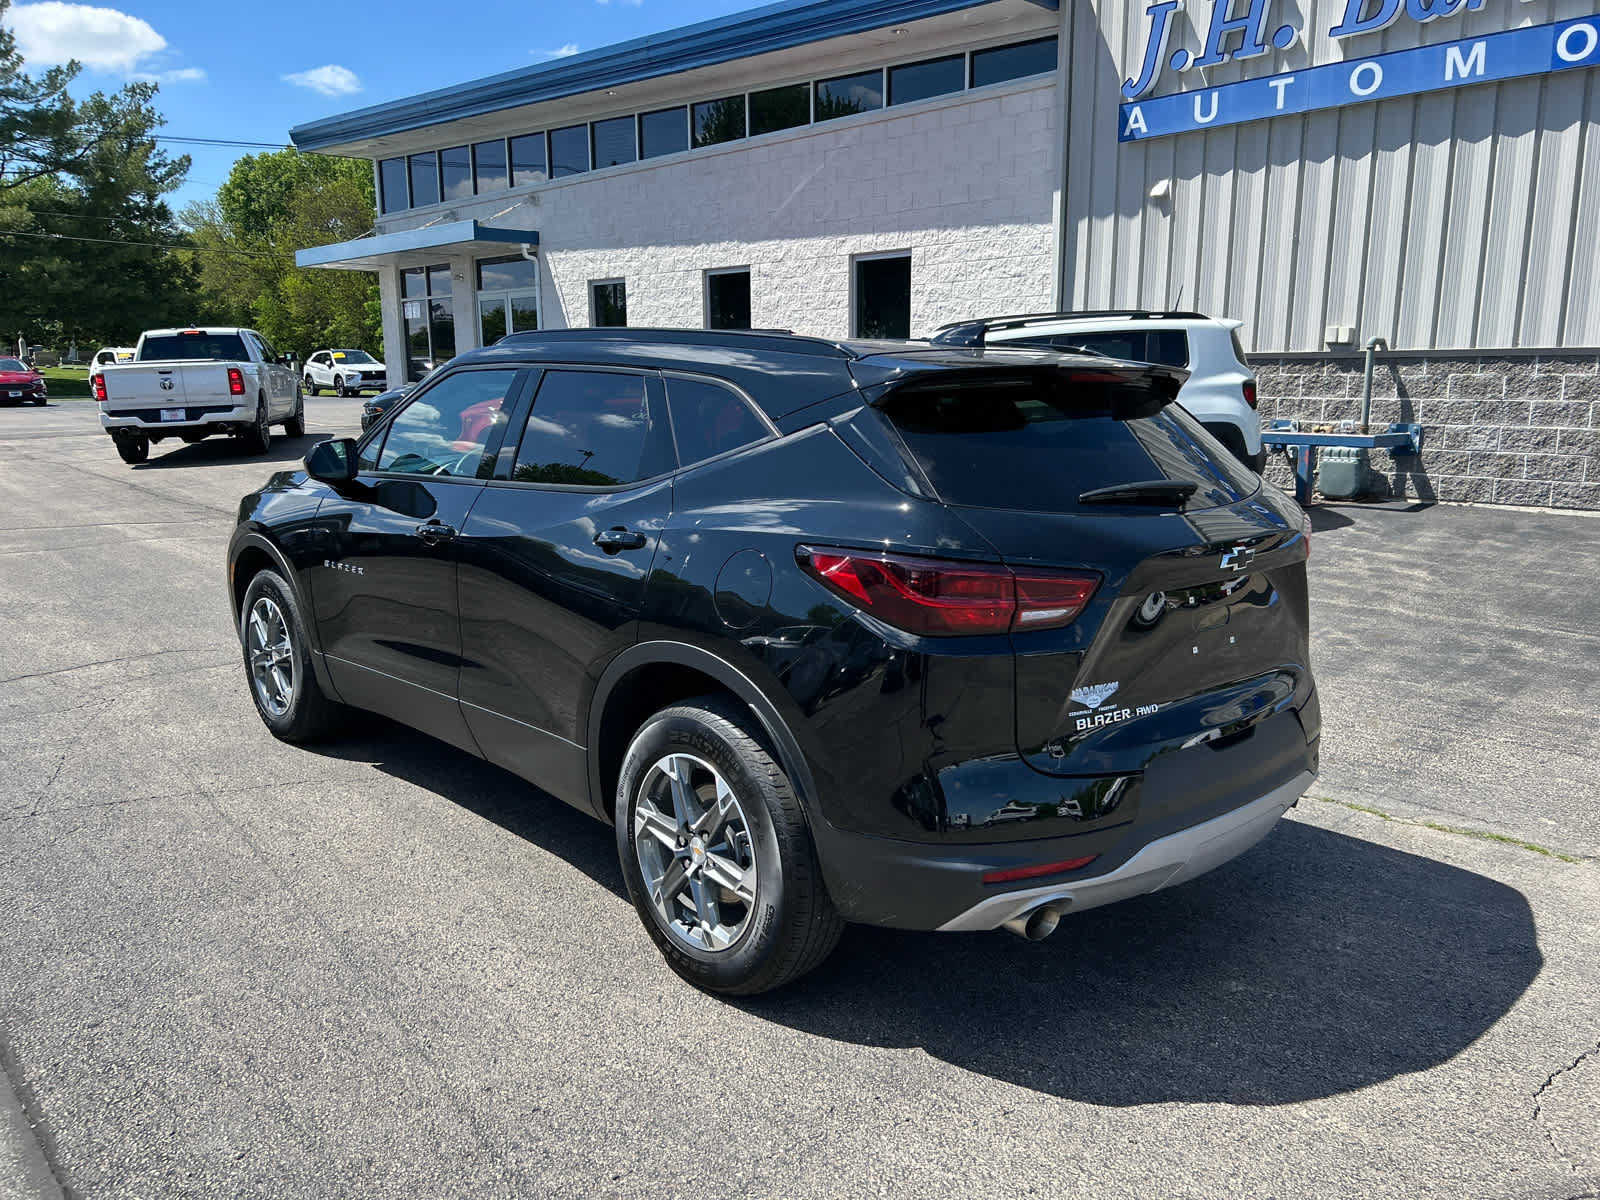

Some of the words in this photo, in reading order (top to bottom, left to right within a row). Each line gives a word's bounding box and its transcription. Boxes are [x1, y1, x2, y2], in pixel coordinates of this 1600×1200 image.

[323, 559, 364, 575] BLAZER
[1076, 708, 1131, 731] BLAZER
[1135, 703, 1158, 717] AWD
